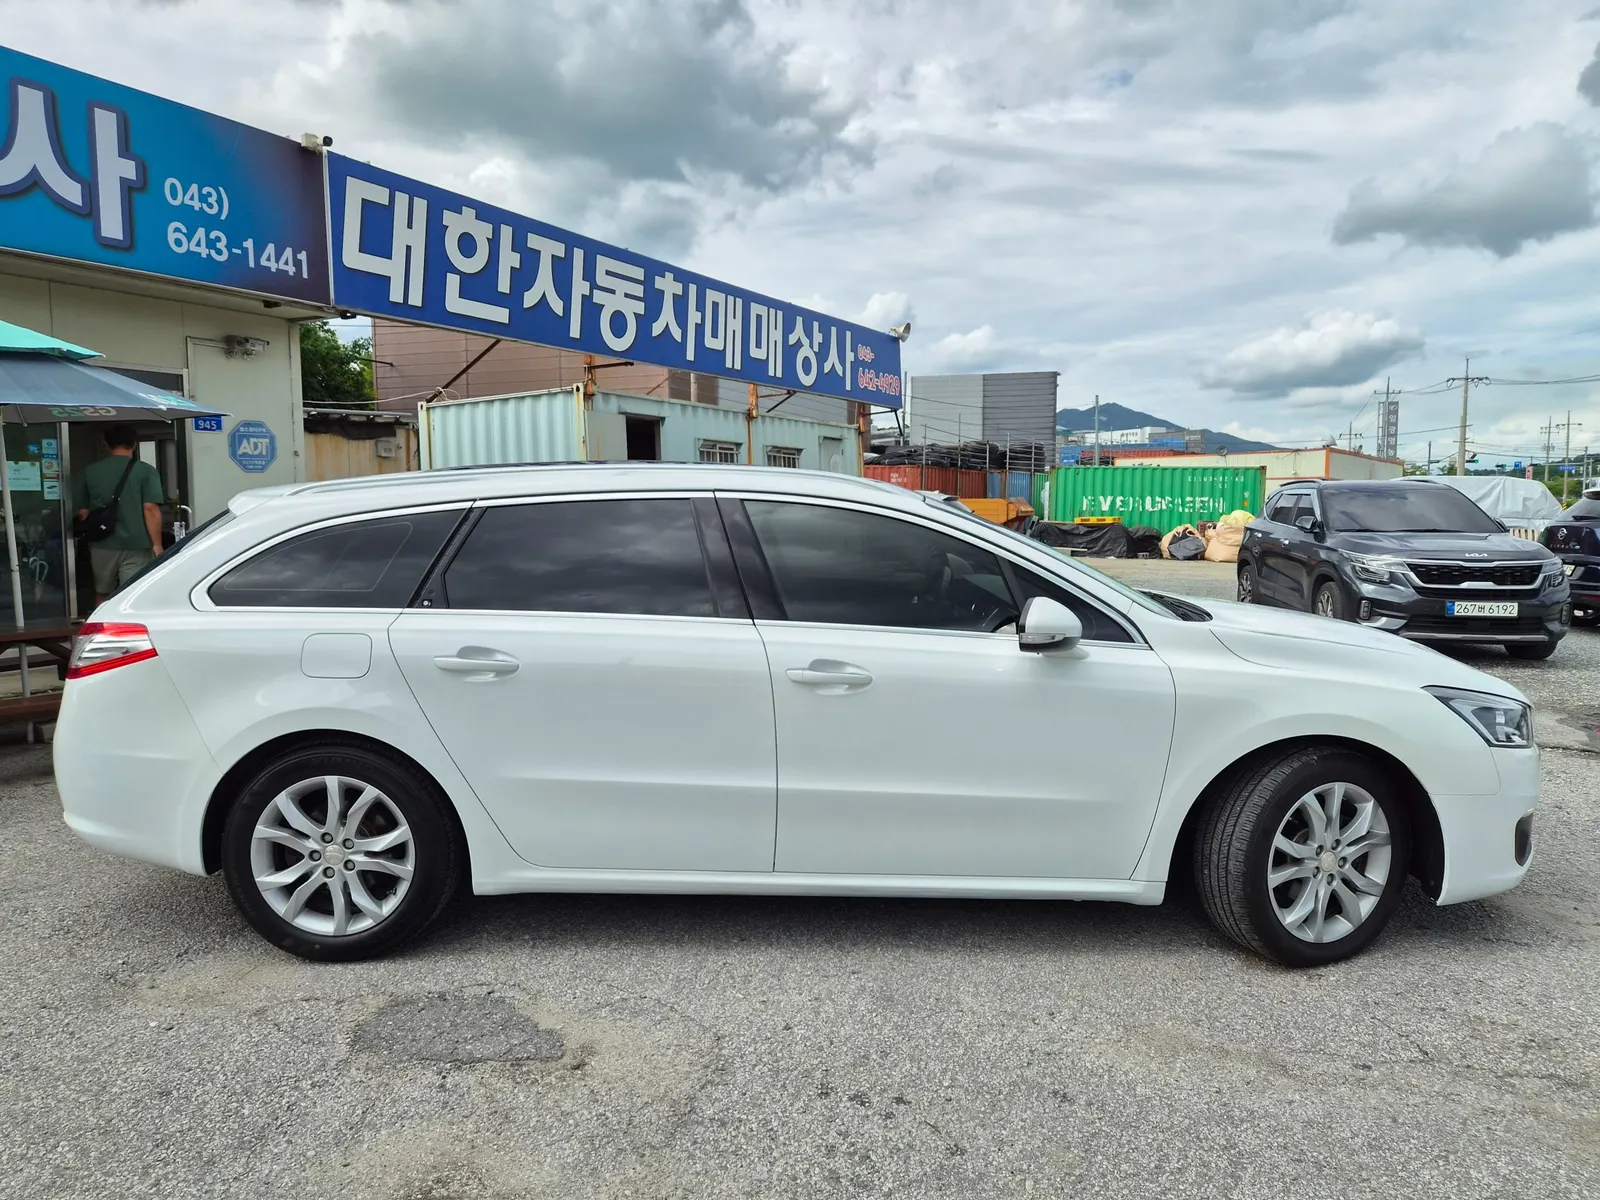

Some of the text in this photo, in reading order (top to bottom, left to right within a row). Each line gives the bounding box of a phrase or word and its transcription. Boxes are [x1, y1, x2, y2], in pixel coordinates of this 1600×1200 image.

[0, 80, 140, 245] 사
[164, 177, 229, 220] 043)
[167, 222, 309, 279] 643-1441
[342, 175, 855, 391] 대한자동차매매상사
[857, 367, 901, 396] 642-4929
[198, 420, 217, 430] 945
[237, 438, 269, 456] ADT
[1456, 603, 1515, 615] 267버 6192
